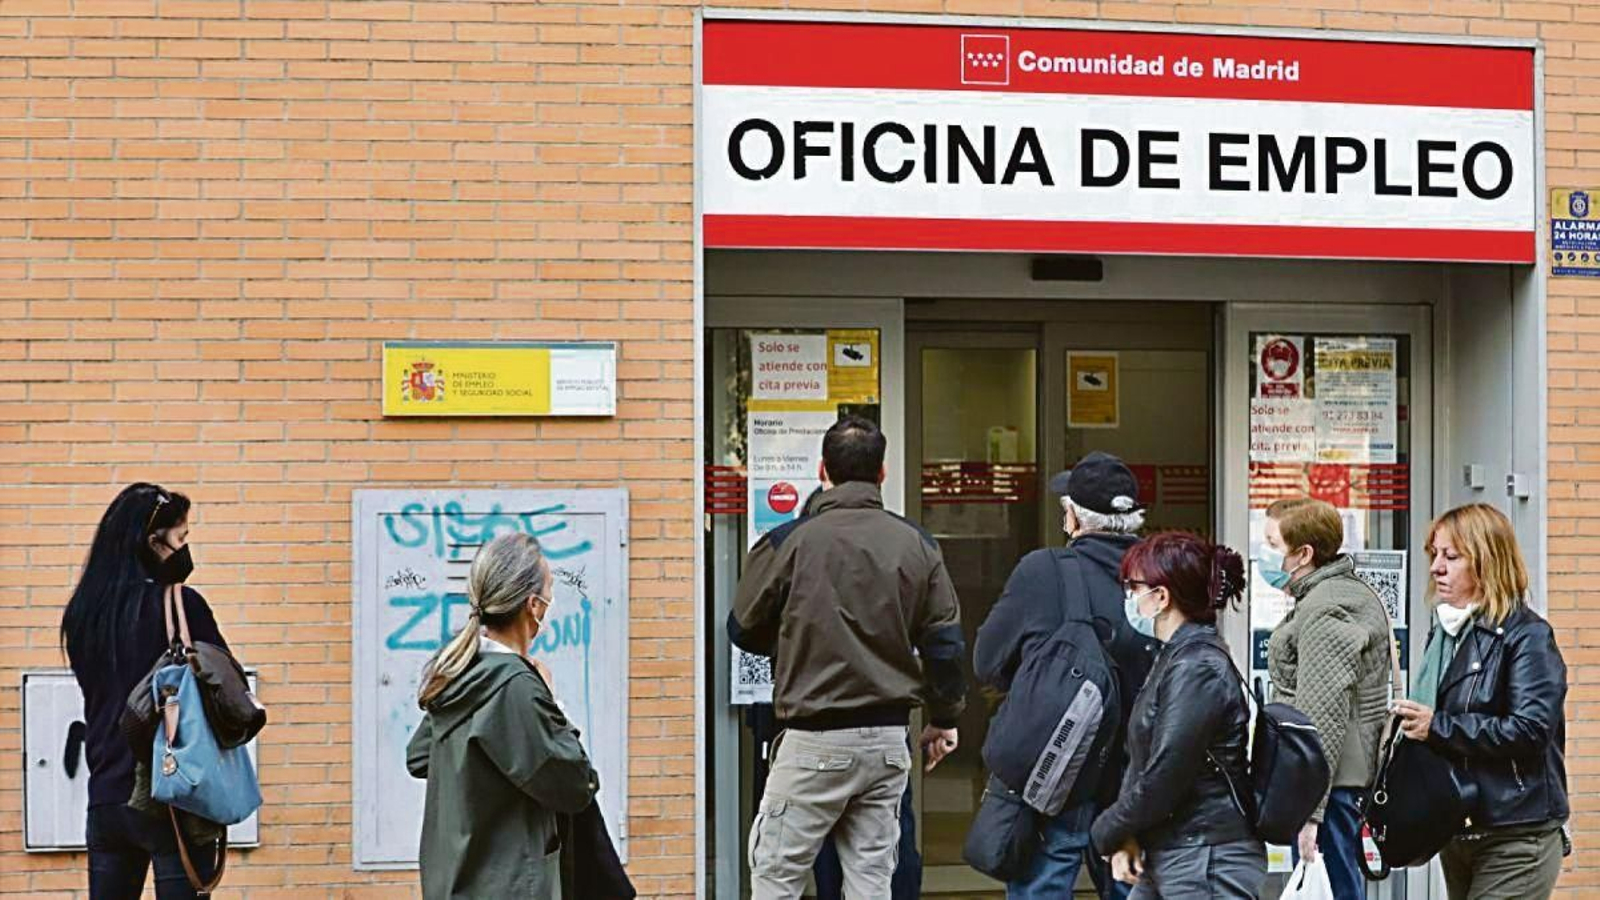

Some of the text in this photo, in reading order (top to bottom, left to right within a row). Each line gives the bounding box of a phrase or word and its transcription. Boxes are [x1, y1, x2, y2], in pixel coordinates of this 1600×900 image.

[1017, 50, 1300, 82] Comunidad de Madrid
[727, 117, 1514, 200] OFICINA DE EMPLEO
[1553, 230, 1600, 241] 24 HORA
[758, 341, 800, 353] Solo se
[758, 361, 827, 372] atiende con
[1350, 356, 1393, 370] PREVIA
[452, 372, 496, 380] MINISTERIO
[452, 380, 494, 389] DE EMPLEO
[758, 379, 781, 391] cita
[783, 380, 820, 392] previa
[459, 389, 503, 397] SEGURIDAD
[505, 389, 533, 397] SOCIAL
[1250, 404, 1275, 416] Solo
[753, 418, 784, 427] Horario
[1250, 423, 1294, 434] atiende
[1052, 718, 1076, 749] PUMA
